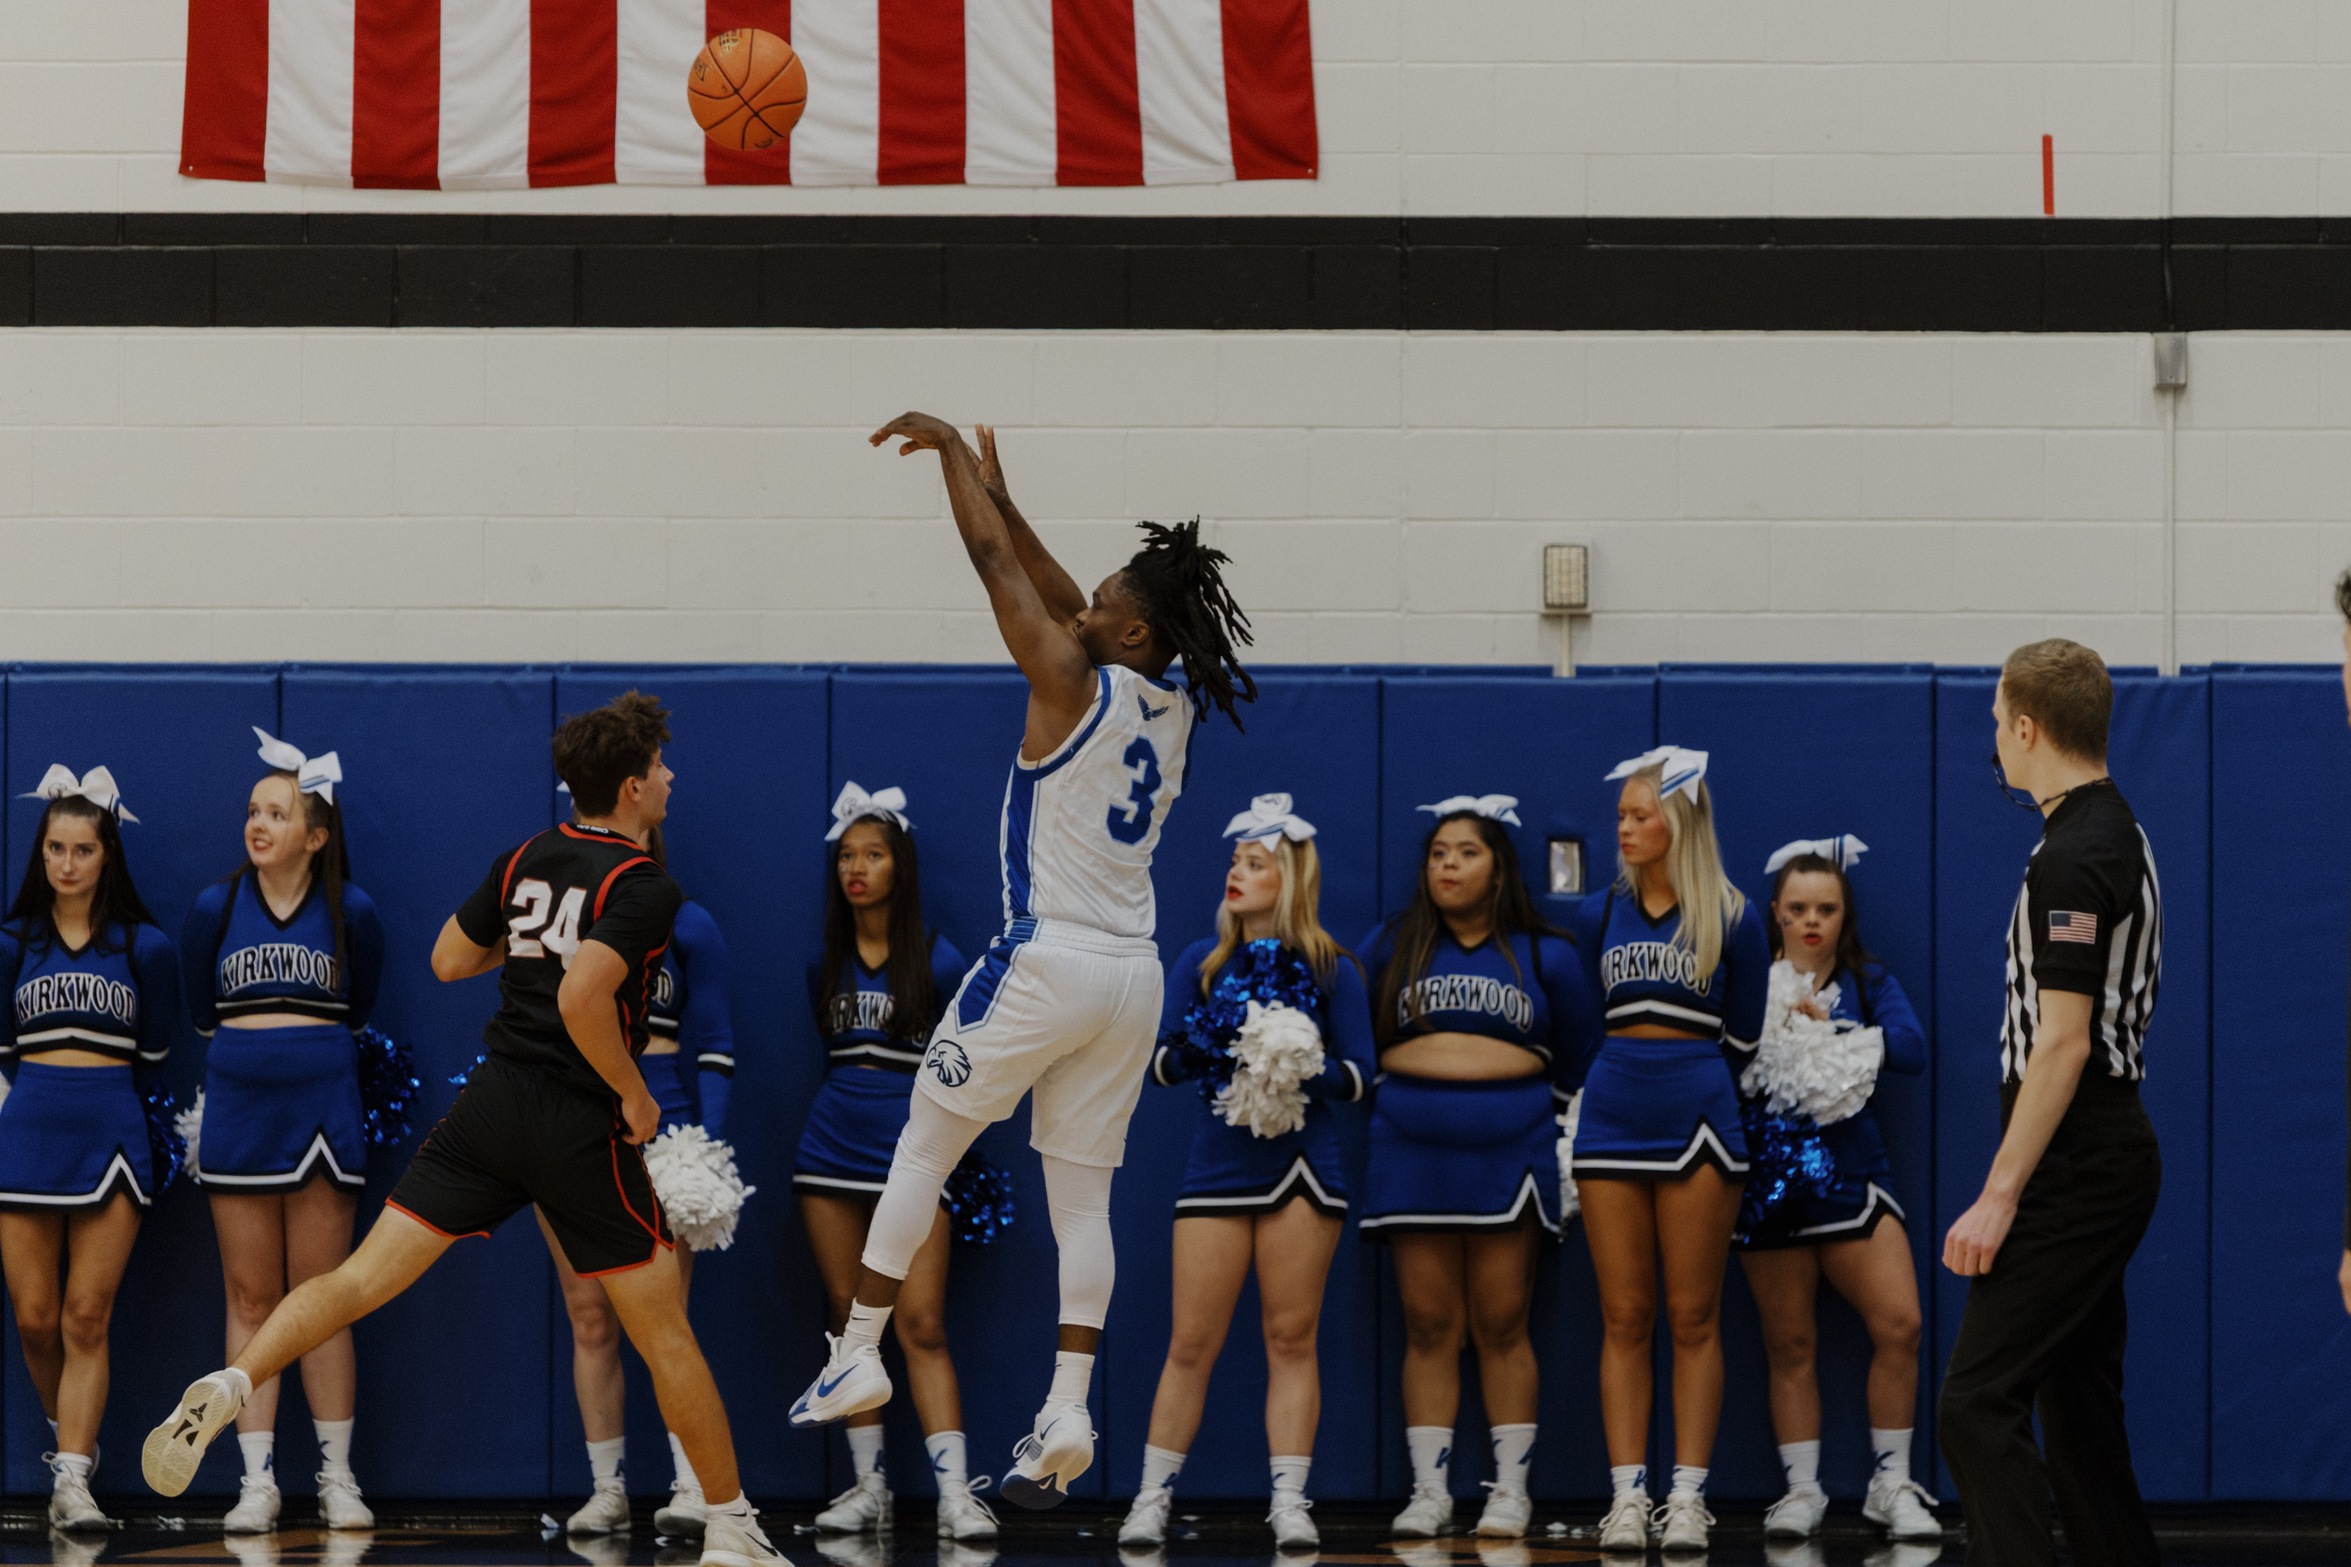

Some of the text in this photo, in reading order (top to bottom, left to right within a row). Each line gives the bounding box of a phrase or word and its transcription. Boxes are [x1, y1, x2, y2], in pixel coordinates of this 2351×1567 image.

[1107, 734, 1162, 847] 3
[507, 877, 588, 971] 24
[16, 972, 136, 1026] KIRKWOOD
